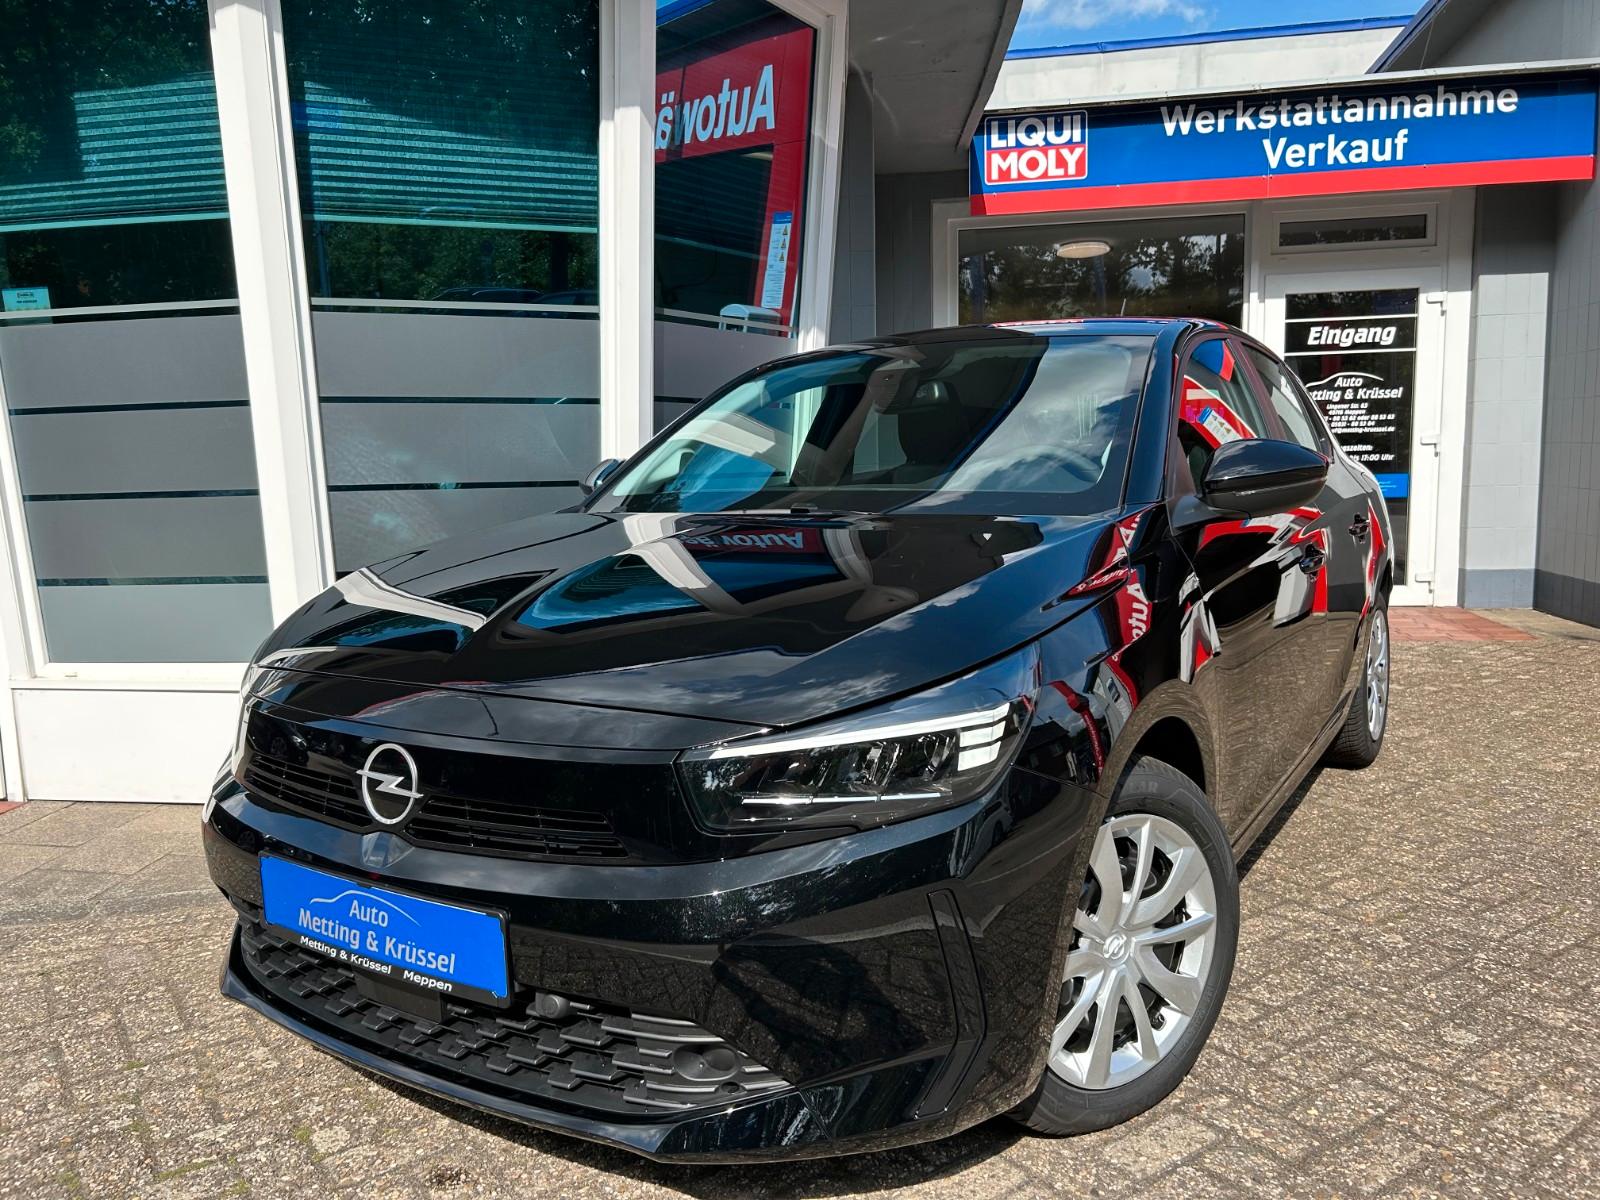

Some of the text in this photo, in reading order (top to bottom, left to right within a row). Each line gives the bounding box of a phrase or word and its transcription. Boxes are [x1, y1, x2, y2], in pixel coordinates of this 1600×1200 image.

[1160, 85, 1518, 137] Werkstattannahme
[990, 114, 1082, 148] LIQUI
[991, 147, 1084, 181] MOLY
[1262, 128, 1408, 169] Verkauf
[1307, 325, 1397, 347] Eingang
[1311, 386, 1404, 402] tting & Krüssel
[1334, 376, 1363, 388] Auto
[1381, 453, 1395, 461] Uhr
[349, 900, 388, 928] Auto
[298, 908, 456, 975] Metting & Krüssel
[300, 935, 453, 992] Metting & Krüssel Meppen
